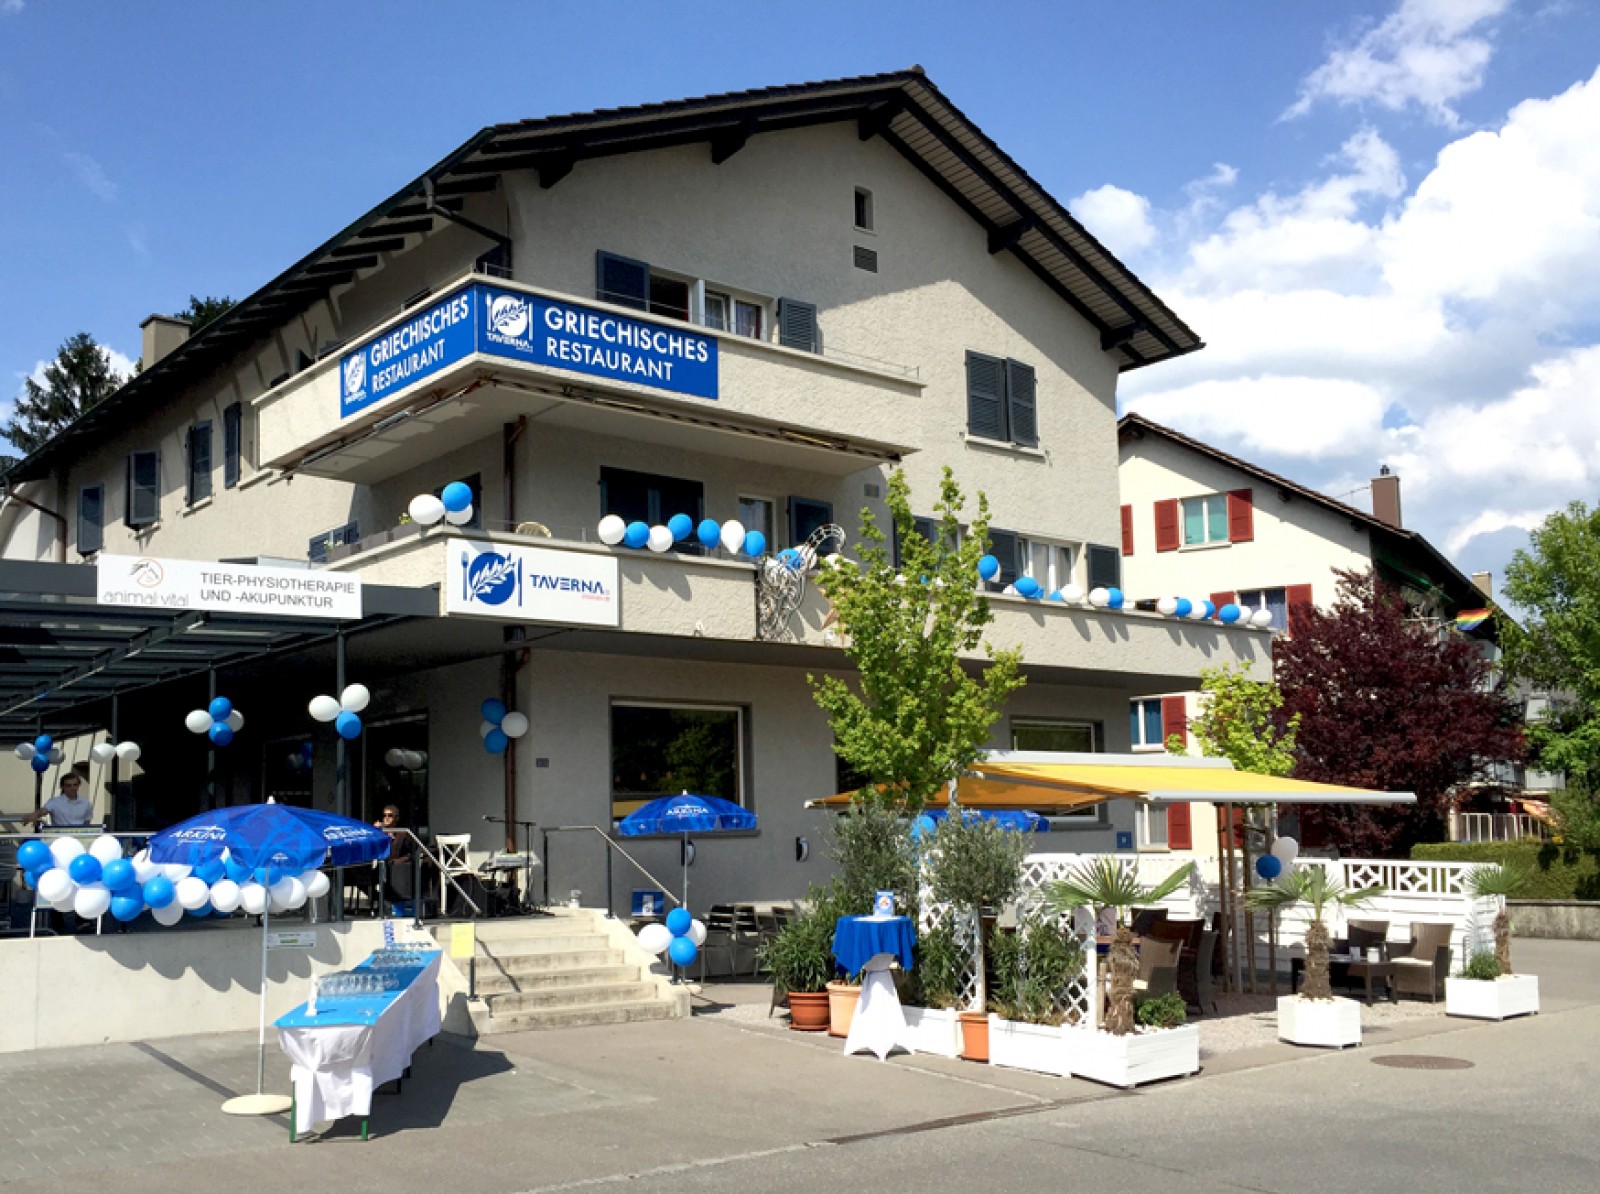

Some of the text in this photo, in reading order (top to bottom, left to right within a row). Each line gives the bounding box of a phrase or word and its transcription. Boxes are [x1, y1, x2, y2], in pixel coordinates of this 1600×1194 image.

[371, 295, 469, 366] GRIECHISCHES
[544, 306, 709, 363] GRIECHISCHES
[372, 338, 446, 393] RESTAURANT
[546, 336, 674, 382] RESTAURANT
[103, 590, 190, 606] animal vital
[200, 589, 334, 608] UND -AKUPUNKTUR
[201, 572, 355, 594] TIER-PHYSIOTHERAPIE
[530, 574, 604, 594] TAVERNA
